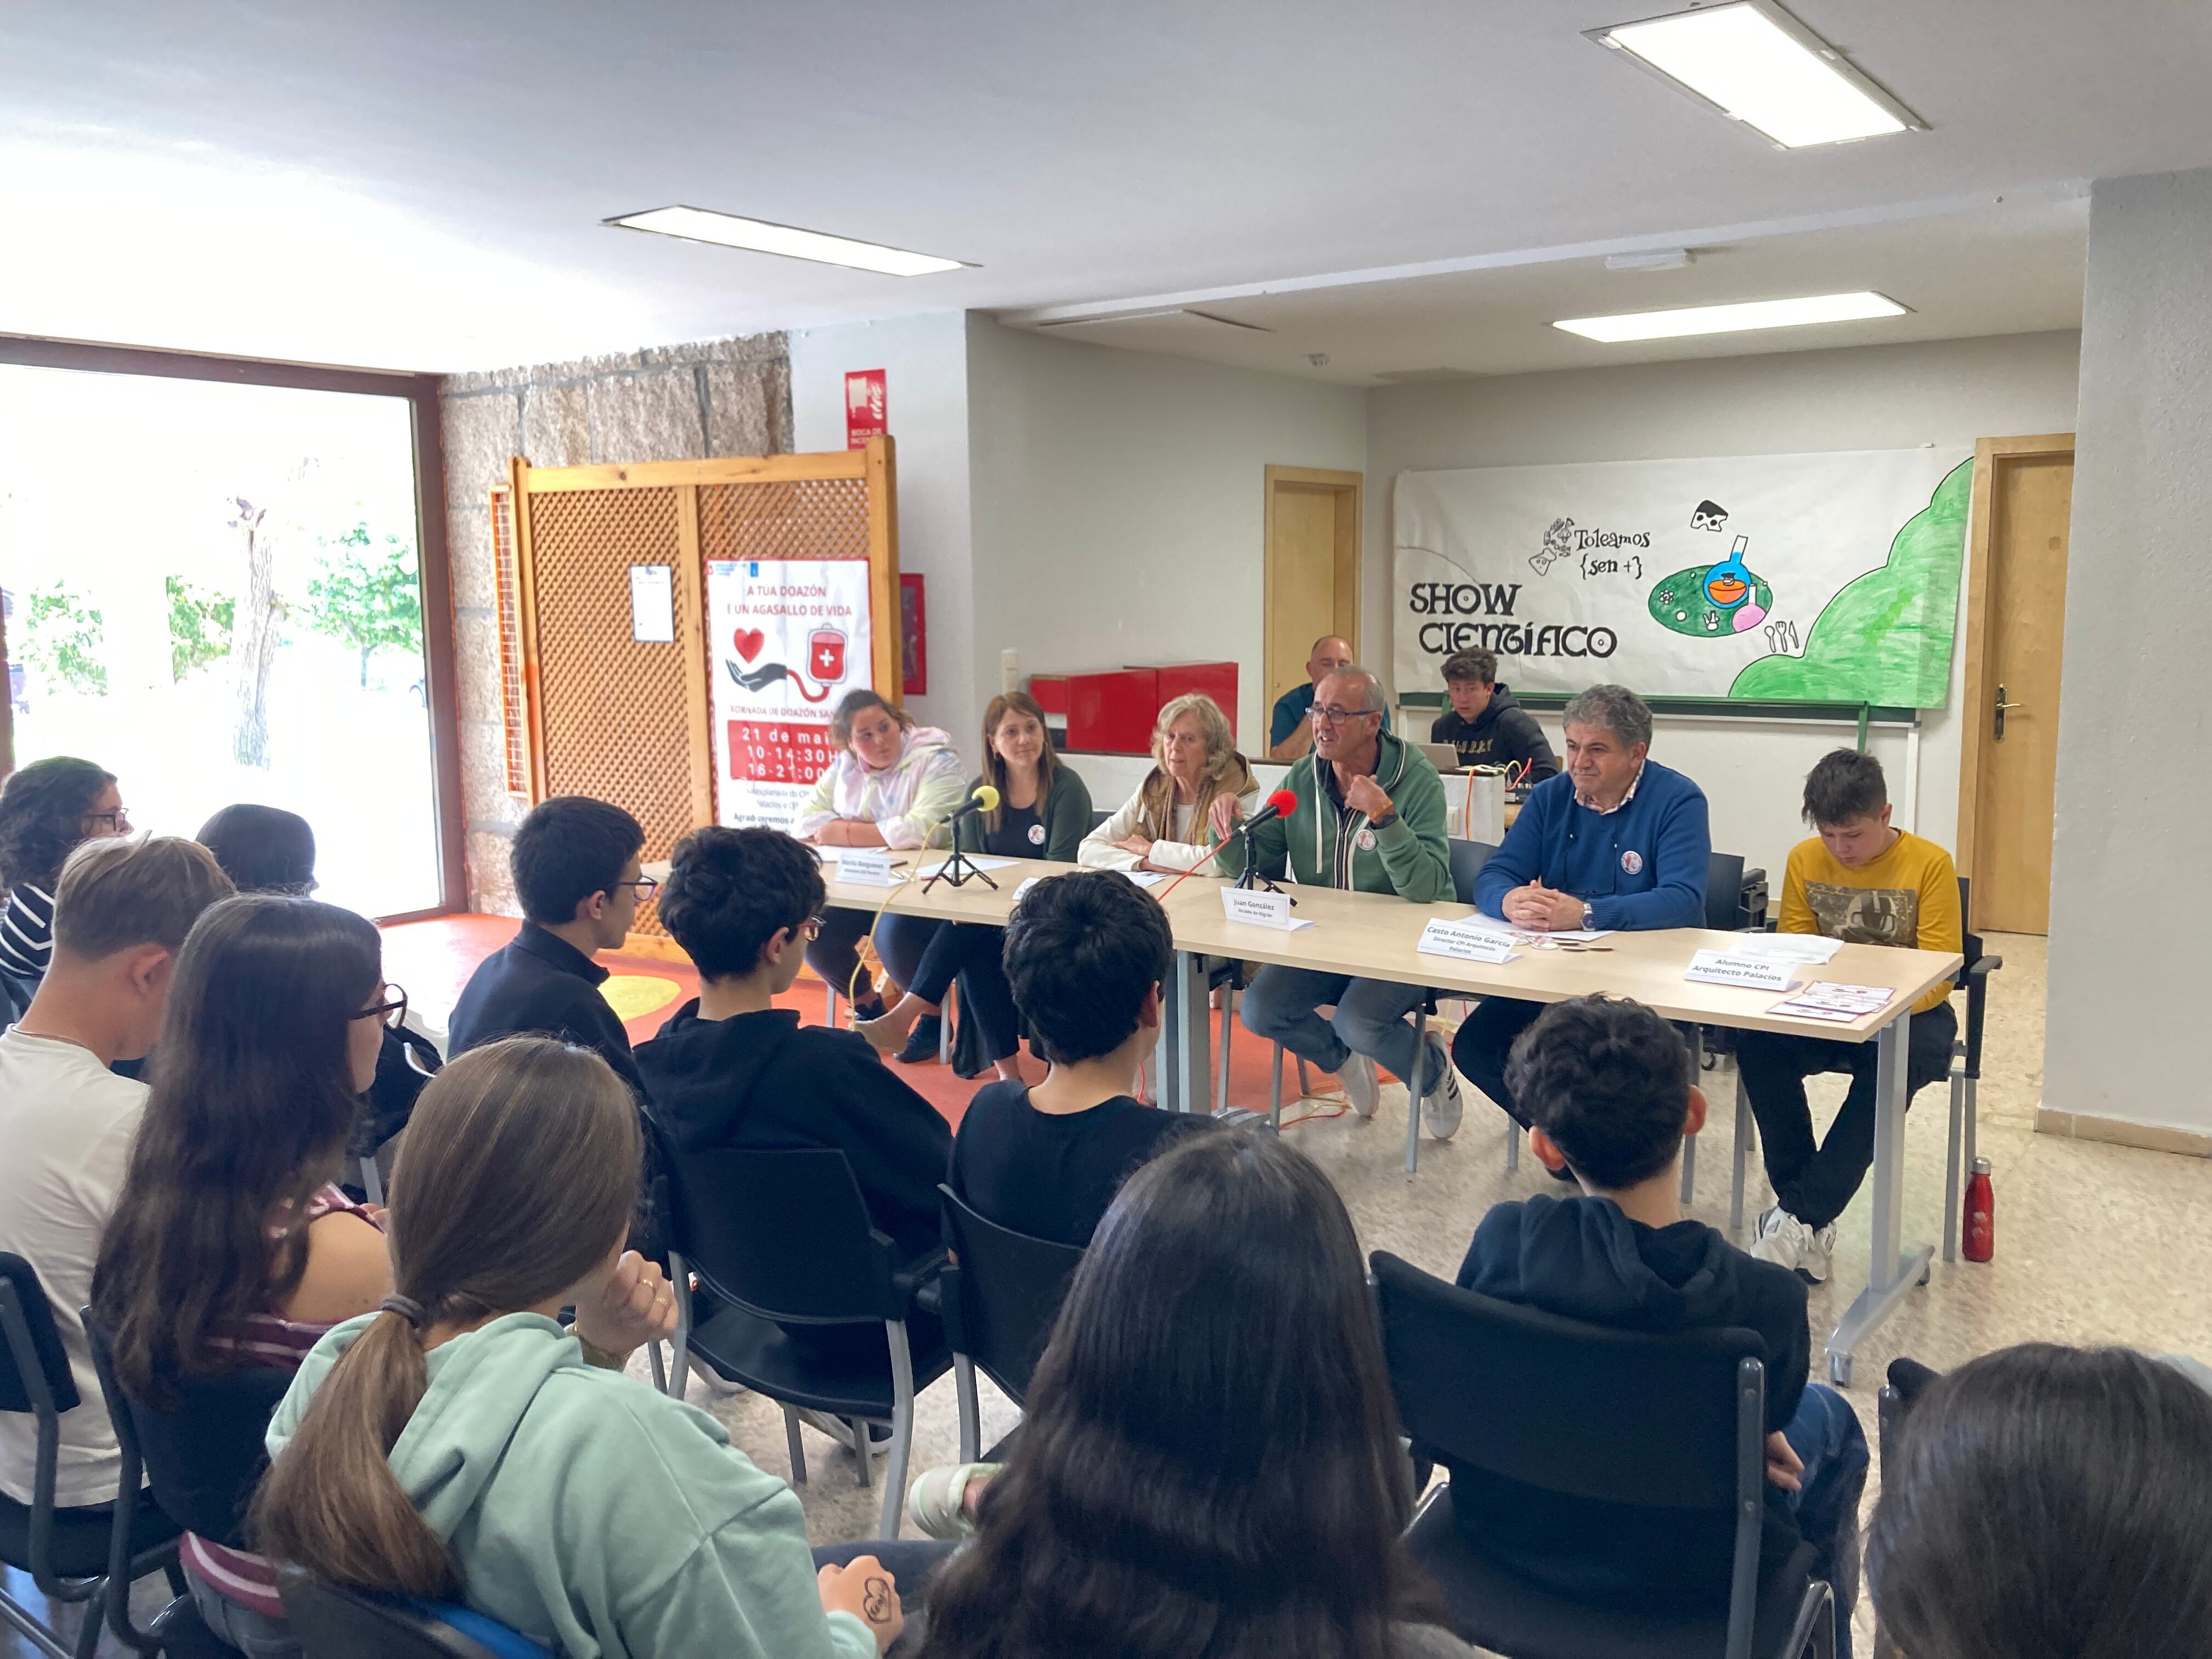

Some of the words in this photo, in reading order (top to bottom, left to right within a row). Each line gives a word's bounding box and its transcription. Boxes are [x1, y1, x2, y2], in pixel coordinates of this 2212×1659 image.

[1574, 528, 1650, 551] Toleamos
[747, 586, 754, 596] A
[757, 584, 777, 596] TÚA
[780, 584, 826, 597] DOAZÓN
[1409, 583, 1522, 616] SHOW
[735, 605, 749, 614] UN
[752, 605, 807, 616] AGASALLO
[810, 605, 823, 616] DE
[826, 606, 852, 616] VIDA
[730, 705, 766, 714] XORNADA
[781, 706, 816, 718] DOAZÓN
[742, 727, 759, 741] 21
[769, 729, 789, 742] de
[798, 731, 829, 744] mai
[1248, 901, 1274, 910] González
[1427, 927, 1449, 935] Casto
[1450, 931, 1482, 941] Antonio
[1484, 937, 1510, 947] García
[1715, 959, 1751, 968] Alumno
[1692, 965, 1741, 976] Arquitecto
[1743, 971, 1782, 981] Palacios
